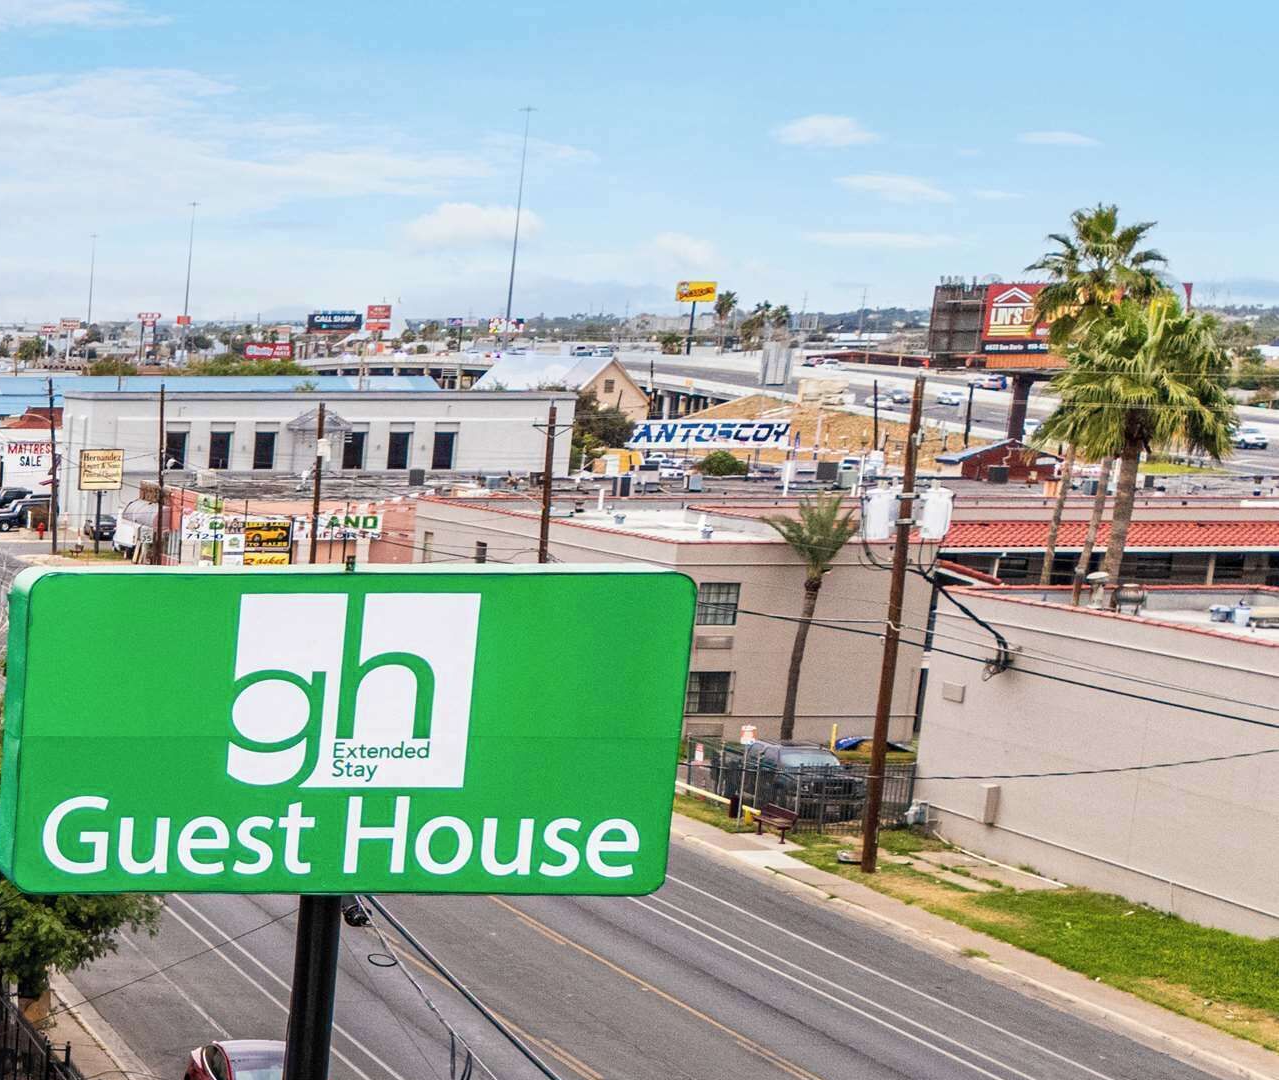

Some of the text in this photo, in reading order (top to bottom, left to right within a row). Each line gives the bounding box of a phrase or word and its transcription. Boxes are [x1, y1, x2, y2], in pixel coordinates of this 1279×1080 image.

[626, 423, 790, 443] ANTOSCOY
[8, 443, 55, 455] MATTRES
[83, 452, 121, 462] Hernandez
[19, 456, 41, 467] SALE
[332, 741, 430, 761] Extended
[331, 760, 378, 782] Stay
[42, 796, 640, 877] Guest House
